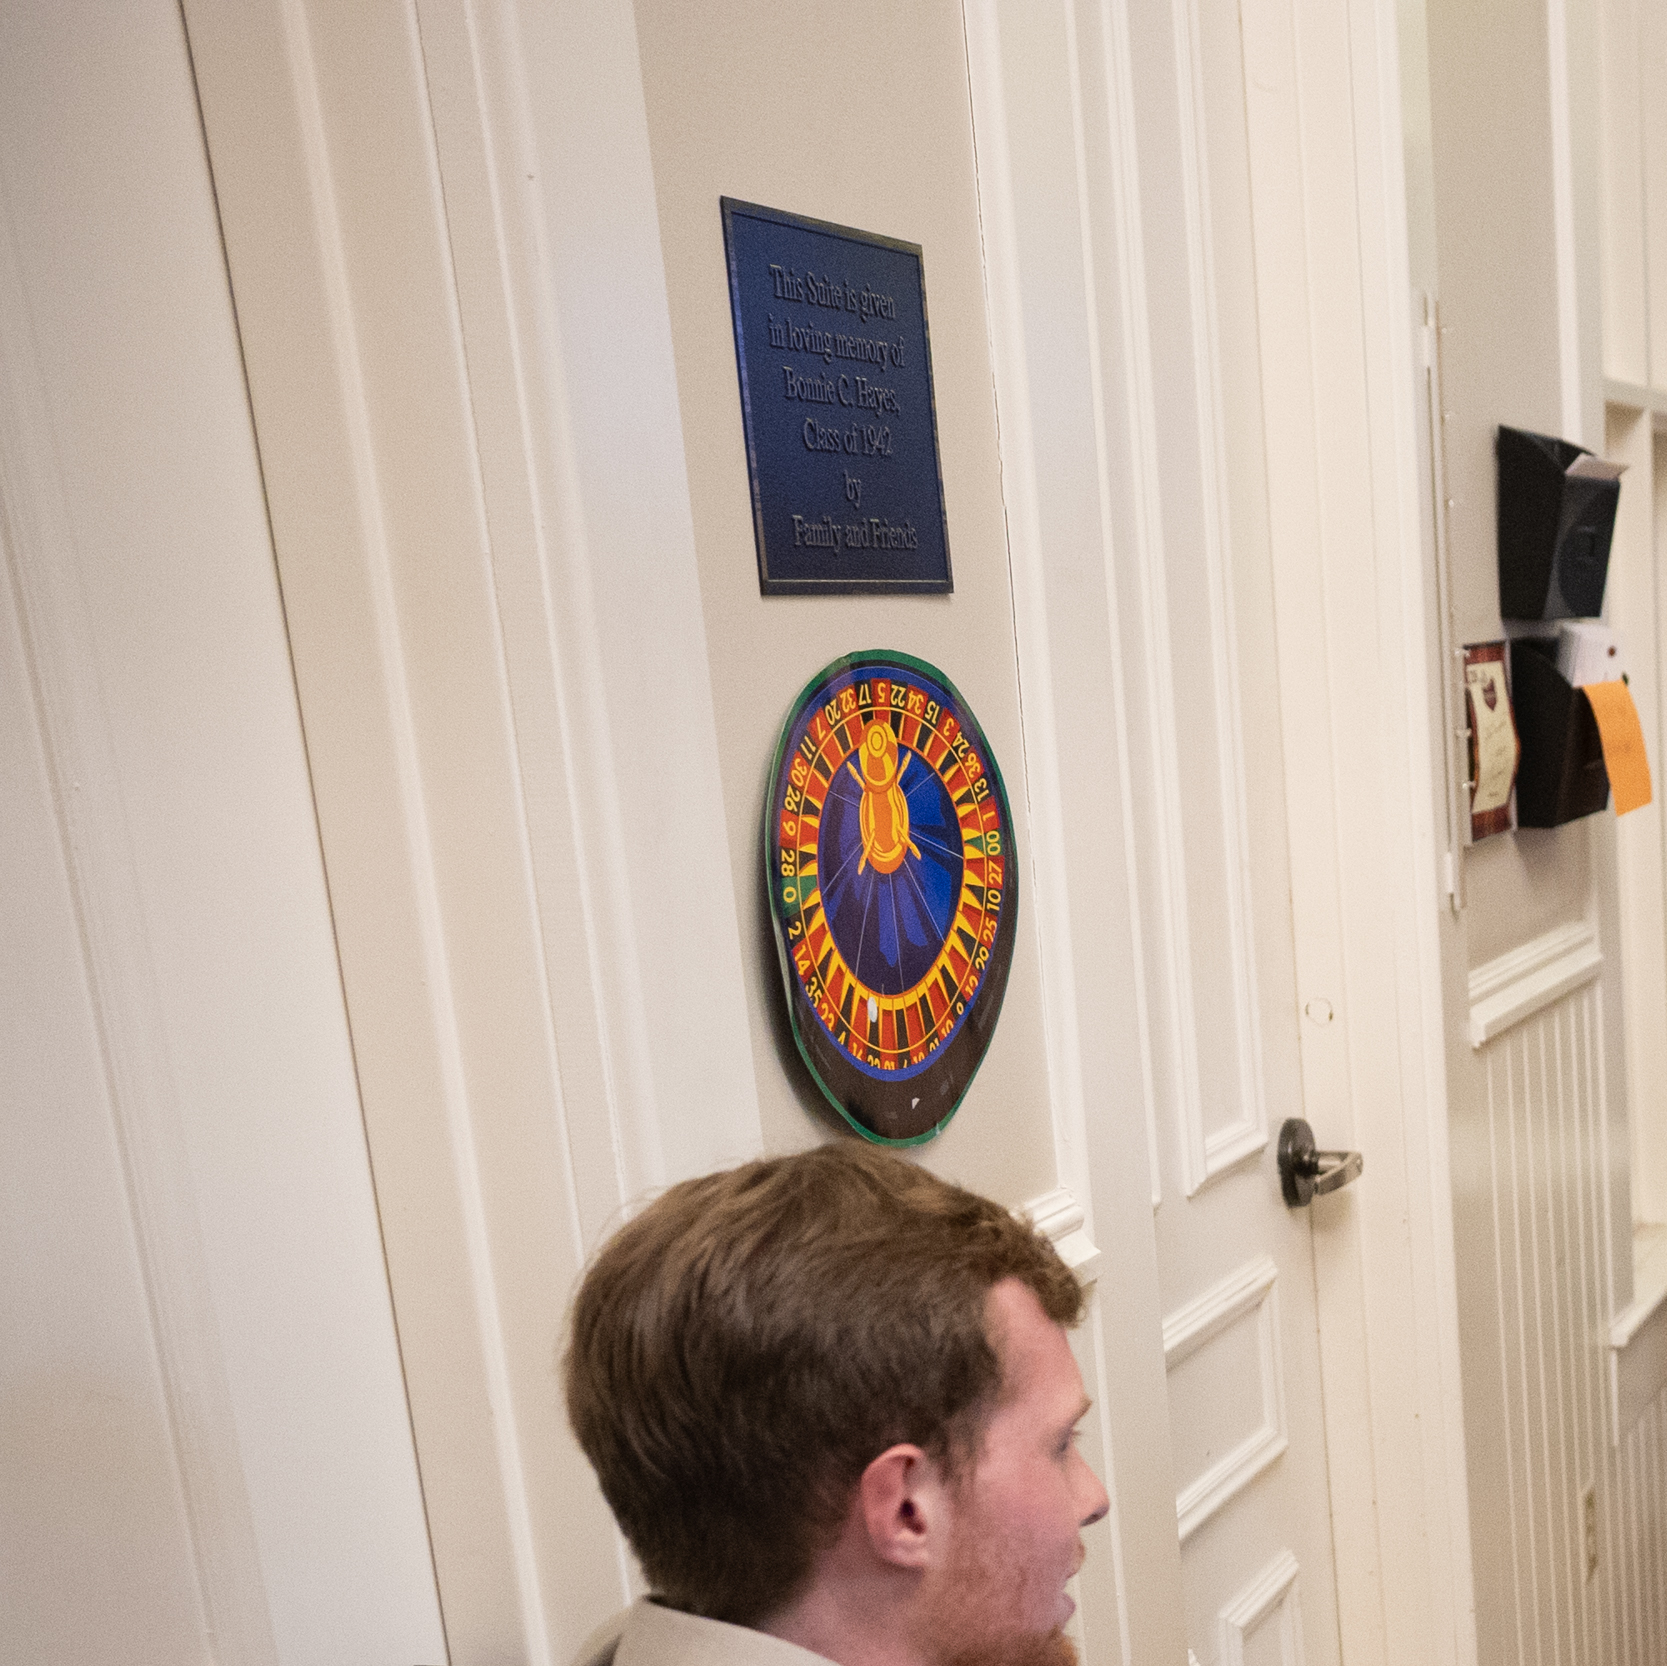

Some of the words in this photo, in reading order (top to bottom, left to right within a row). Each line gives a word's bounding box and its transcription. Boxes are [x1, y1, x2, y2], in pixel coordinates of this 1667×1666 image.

[769, 263, 803, 301] This
[806, 271, 842, 310] Suite
[844, 278, 857, 312] is
[860, 282, 896, 323] given
[768, 313, 785, 348] in
[786, 317, 832, 365] loving
[835, 333, 888, 372] memory
[891, 336, 905, 368] of
[782, 366, 835, 404] Bonnie
[837, 374, 854, 408] C.
[803, 417, 841, 454] Class
[843, 423, 858, 455] of
[861, 424, 893, 458] 1942
[843, 469, 862, 510] by
[792, 514, 842, 555] Family
[845, 517, 869, 549] and
[869, 518, 919, 550] Friends
[840, 688, 857, 713] 32
[858, 684, 871, 706] 17
[877, 682, 887, 703] 5
[890, 684, 907, 707] 22
[907, 690, 924, 714] 34
[825, 699, 841, 725] 20
[924, 701, 940, 725] 15
[816, 717, 826, 740] 7
[943, 718, 955, 736] 3
[800, 736, 816, 760] 11
[952, 732, 970, 758] 24
[791, 758, 808, 787] 30
[965, 753, 981, 778] 36
[784, 784, 800, 812] 26
[974, 778, 990, 802] 13
[982, 810, 996, 822] 1
[986, 830, 1001, 856] 00
[781, 849, 796, 877] 28
[988, 860, 1003, 885] 27
[783, 886, 797, 903] 0
[986, 889, 1001, 911] 10
[788, 921, 802, 940] 2
[983, 917, 997, 943] 25
[794, 944, 811, 975] 14
[805, 977, 823, 1008] 35
